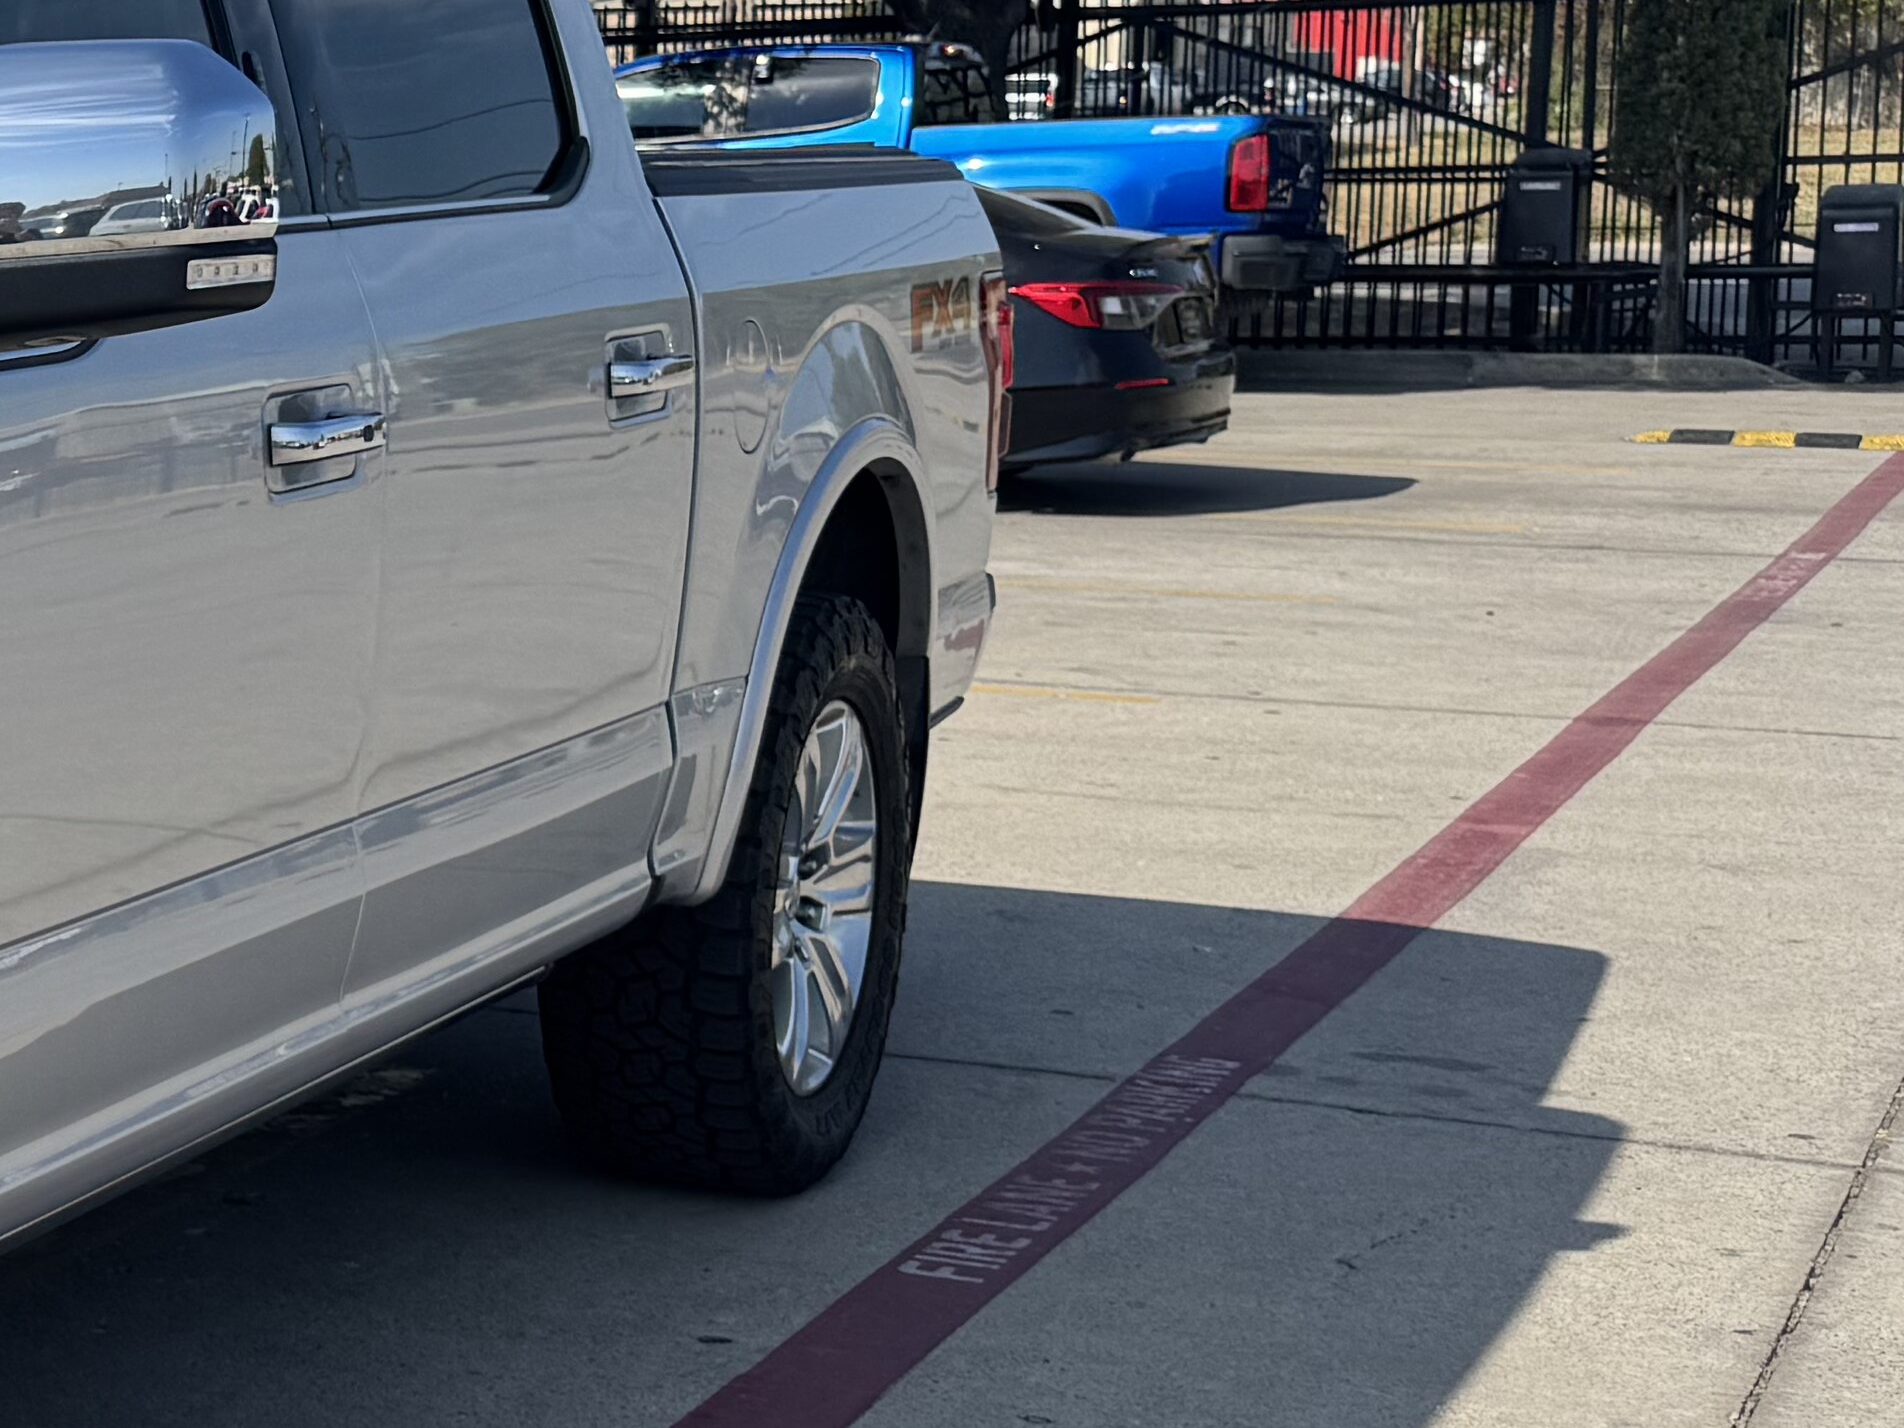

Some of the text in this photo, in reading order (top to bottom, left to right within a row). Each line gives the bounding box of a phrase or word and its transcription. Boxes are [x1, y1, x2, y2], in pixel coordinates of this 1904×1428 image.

[910, 275, 971, 354] FX4
[897, 1053, 1243, 1284] FIRE LANE NO PARKING
